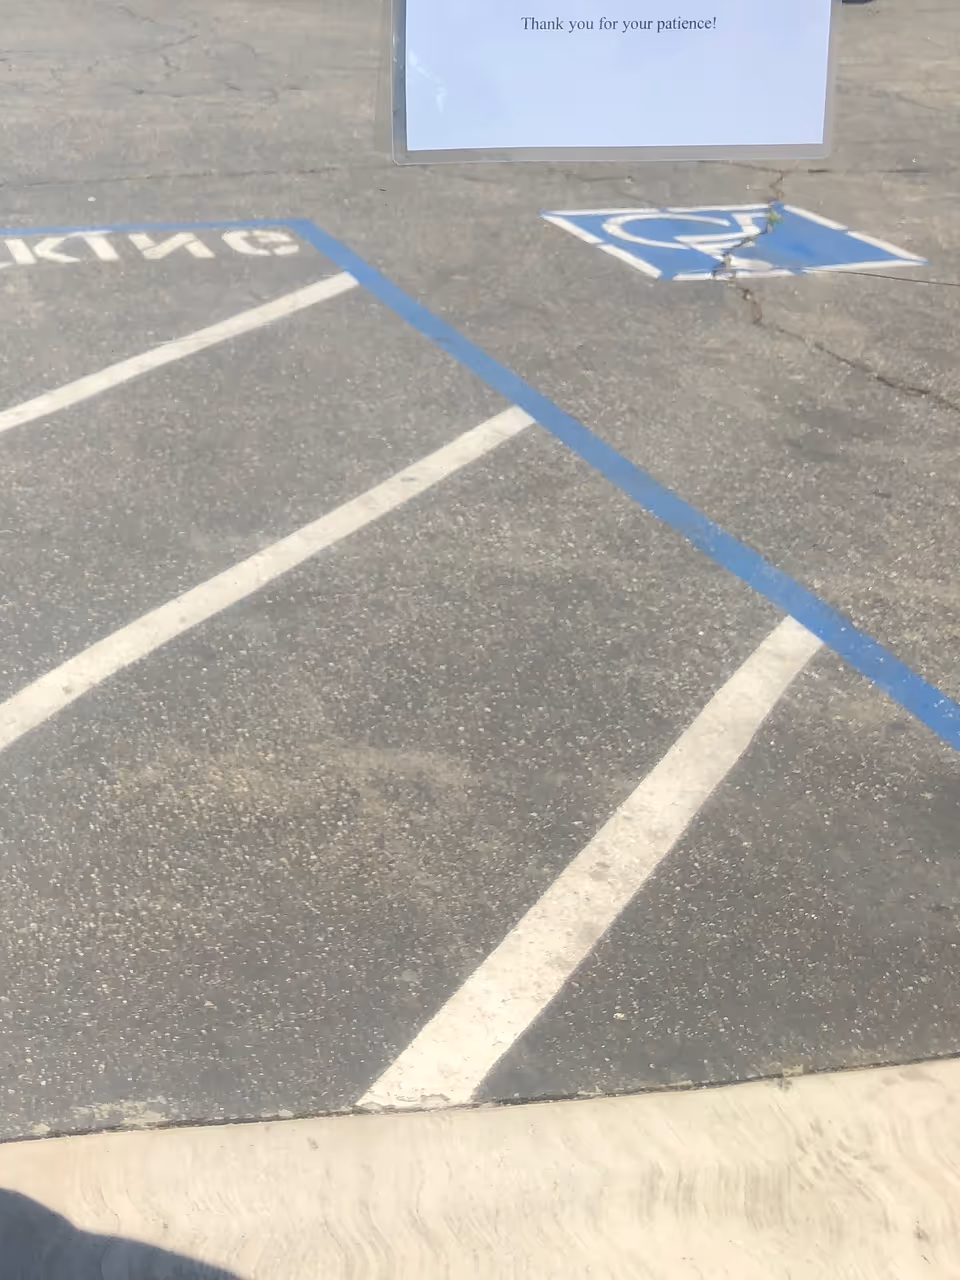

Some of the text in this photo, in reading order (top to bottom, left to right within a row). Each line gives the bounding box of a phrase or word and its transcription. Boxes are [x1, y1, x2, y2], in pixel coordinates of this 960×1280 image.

[520, 16, 717, 33] Thank you for your patience!
